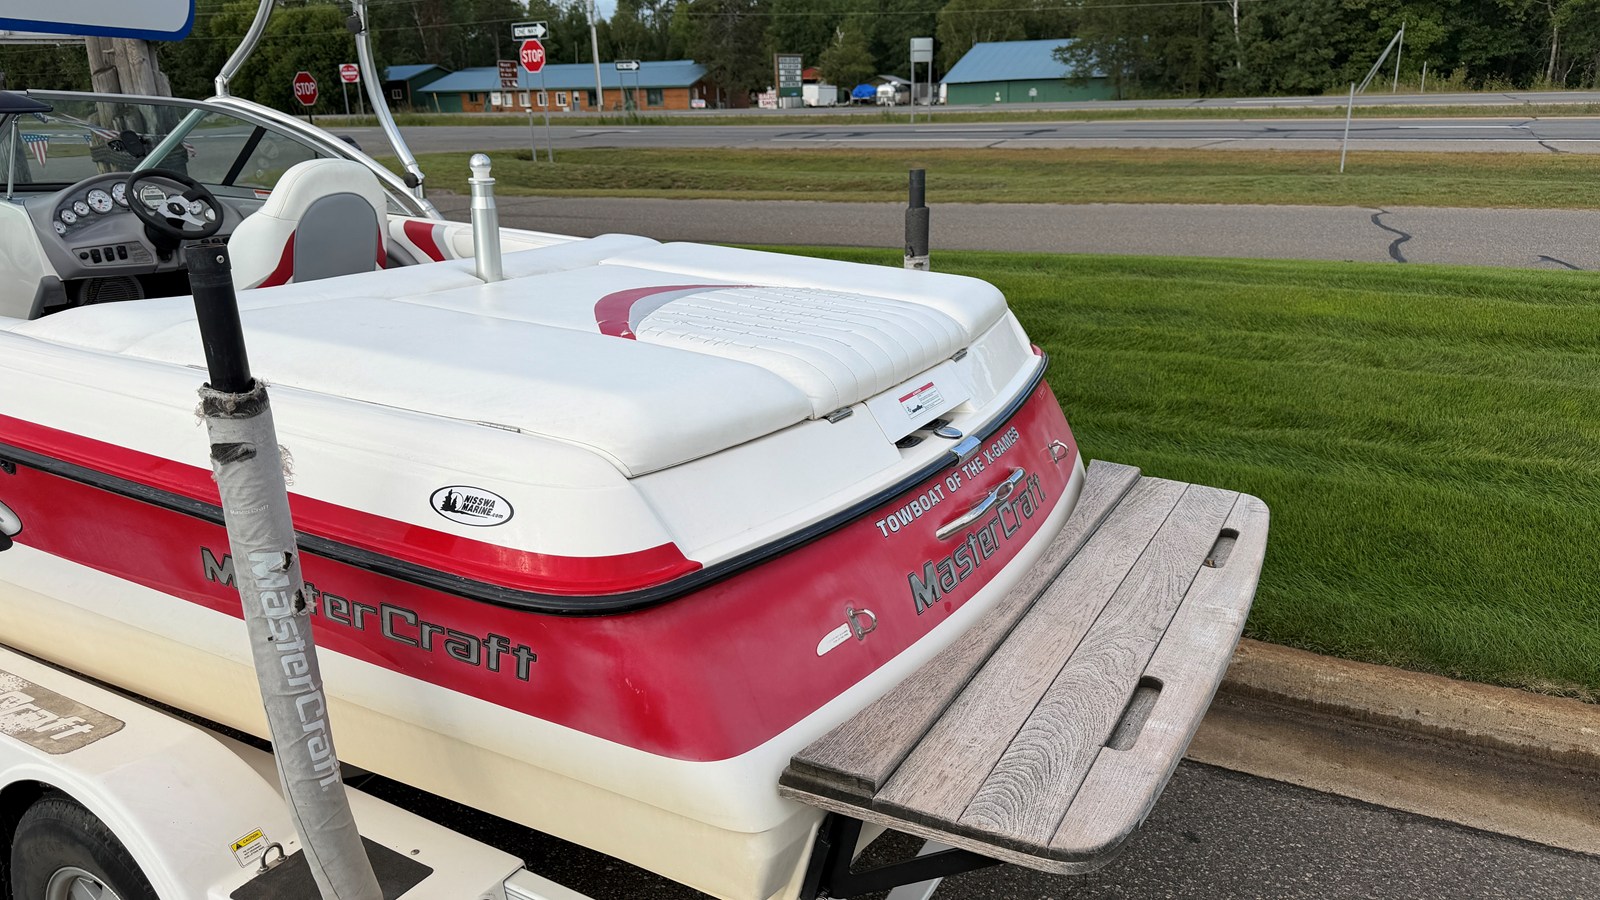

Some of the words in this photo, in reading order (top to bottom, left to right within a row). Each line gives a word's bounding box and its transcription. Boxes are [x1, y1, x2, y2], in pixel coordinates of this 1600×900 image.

[522, 49, 543, 63] STOP
[295, 82, 316, 96] STOP
[463, 494, 496, 509] NISSWA
[875, 483, 945, 538] TOWBOAT
[945, 471, 962, 493] OF
[961, 456, 985, 480] THE
[983, 426, 1020, 465] X-GAMES
[907, 472, 1046, 615] MasterCraft
[200, 546, 538, 682] MterCraft
[247, 551, 341, 788] MasterCraft
[242, 832, 259, 844] CAUTION
